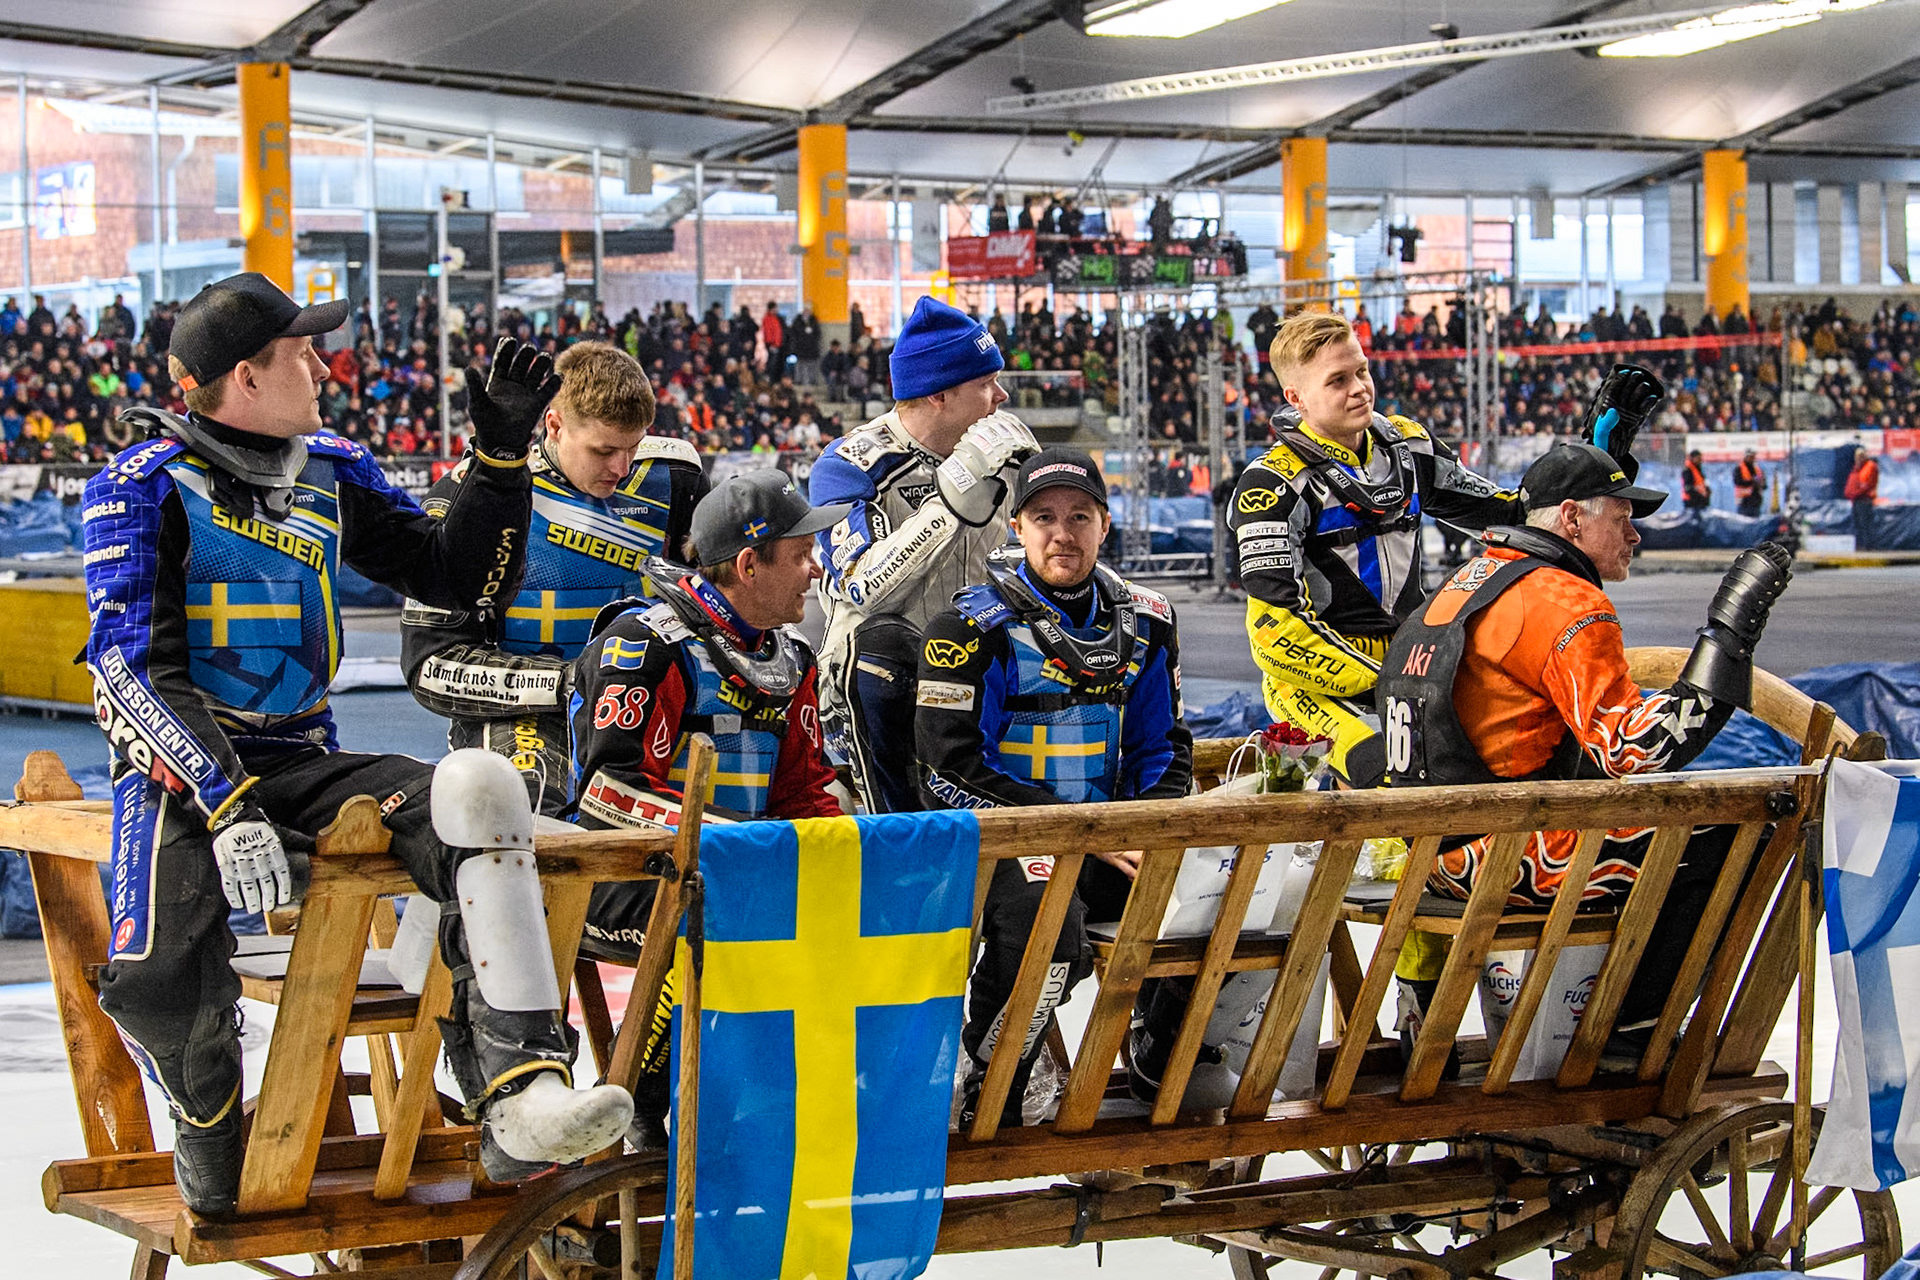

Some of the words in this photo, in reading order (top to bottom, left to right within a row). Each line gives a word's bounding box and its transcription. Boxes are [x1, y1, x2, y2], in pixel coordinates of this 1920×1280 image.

[907, 442, 942, 467] WACO
[1453, 480, 1489, 495] WACO
[212, 504, 325, 572] SWEDEN
[1257, 647, 1312, 680] Components
[1315, 675, 1329, 688] Oy
[1330, 681, 1347, 693] Ltd
[1272, 637, 1346, 675] PERTU
[1402, 644, 1436, 676] Aki
[104, 655, 166, 731] JONSSON
[504, 672, 556, 691] Tidning
[593, 684, 650, 730] 58
[1290, 688, 1339, 736] PERTU
[233, 829, 264, 847] Wulf
[1563, 991, 1592, 1004] FUC
